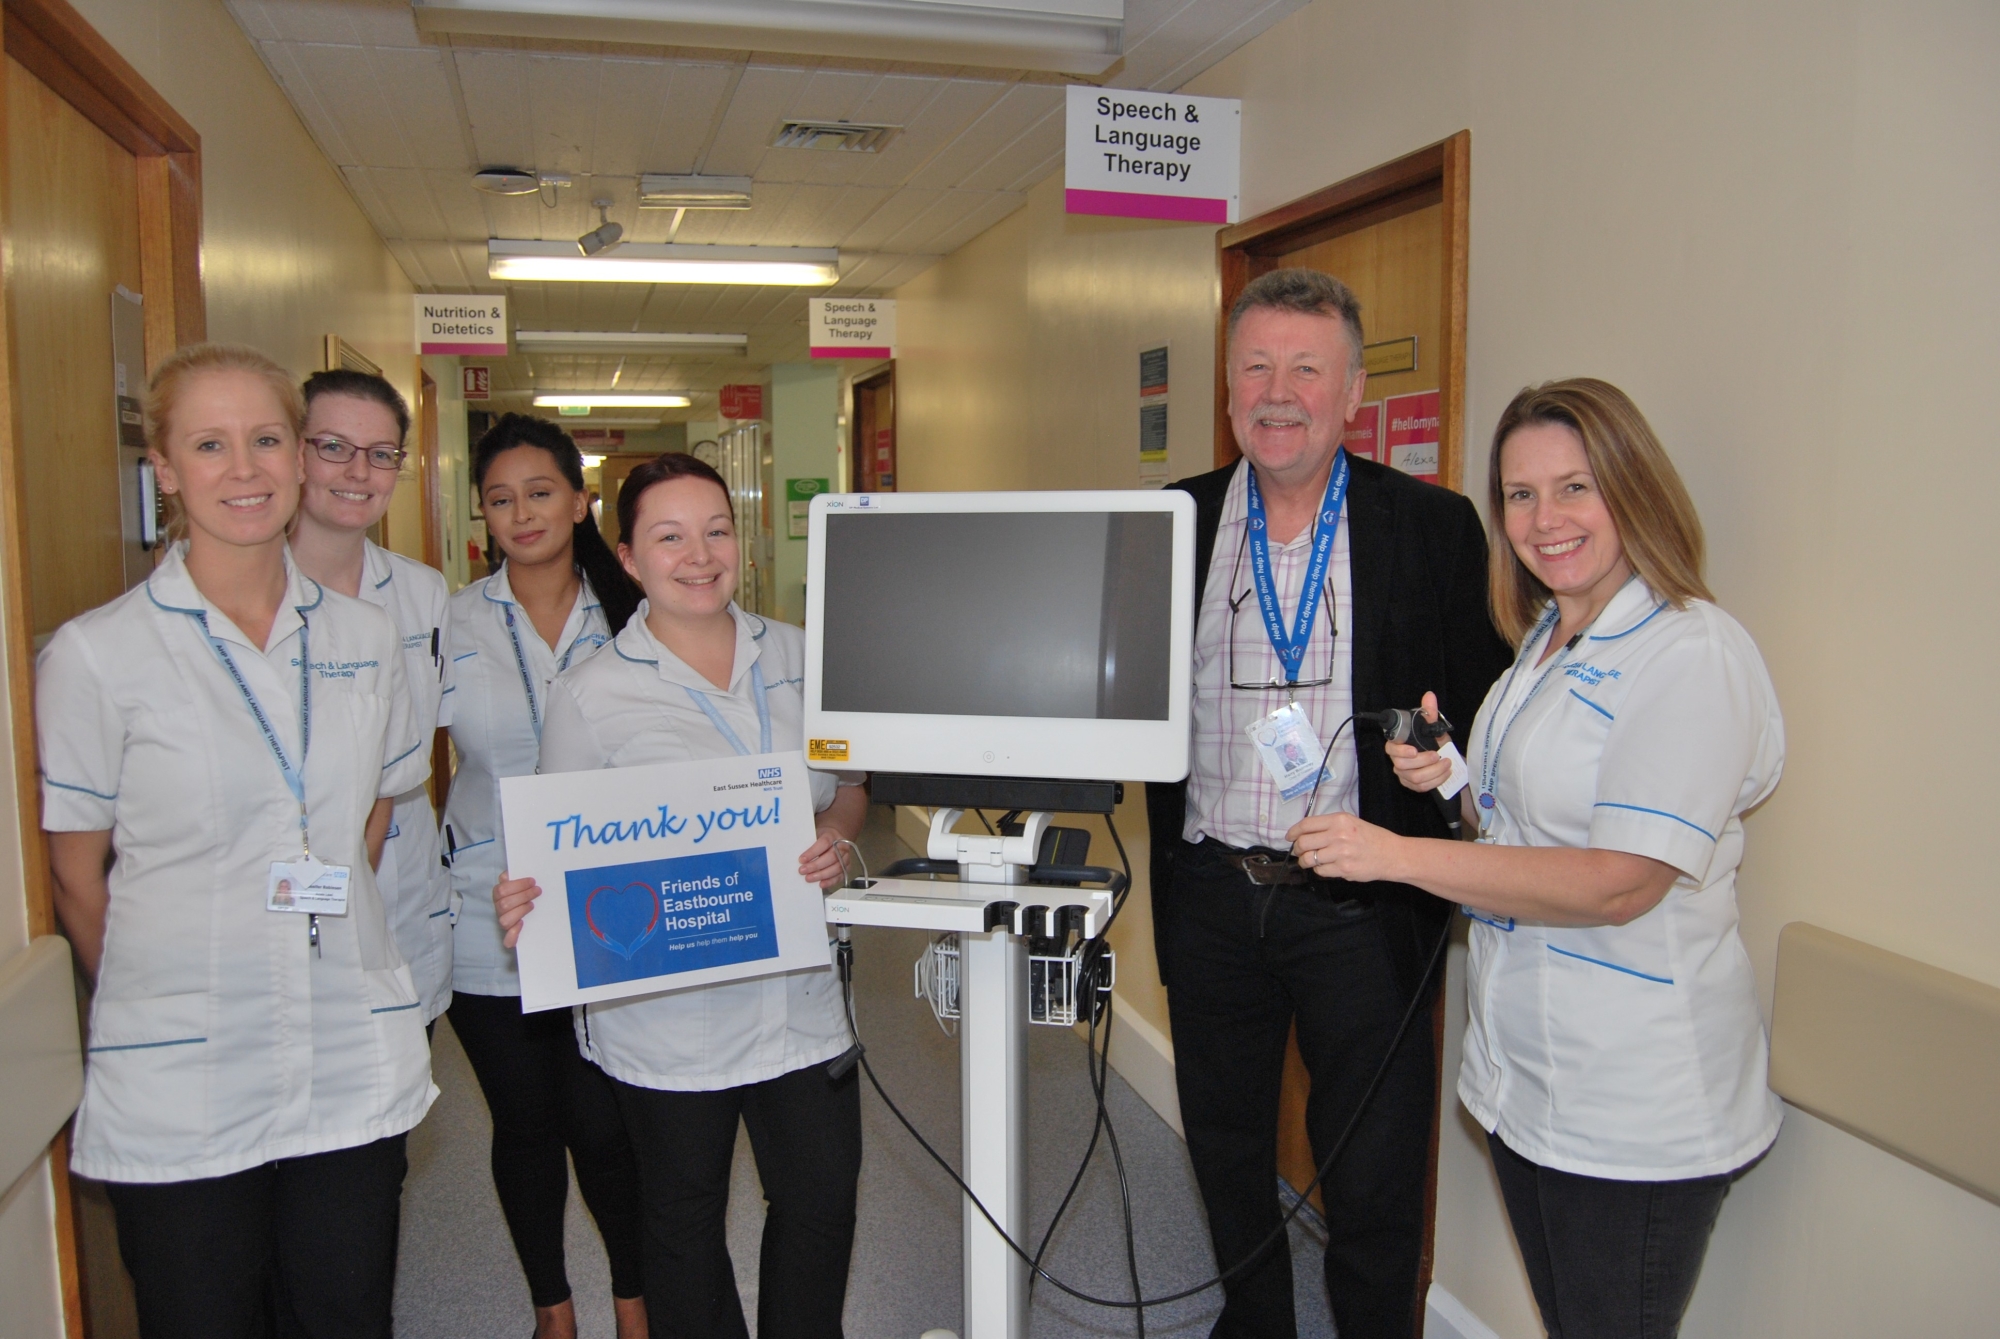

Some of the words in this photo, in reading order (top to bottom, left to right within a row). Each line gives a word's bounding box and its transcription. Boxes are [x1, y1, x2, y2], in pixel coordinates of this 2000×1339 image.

[1097, 96, 1176, 121] Speech
[1184, 104, 1199, 123] &
[1095, 124, 1201, 154] Language
[1103, 152, 1191, 182] Therapy
[424, 306, 486, 319] Nutrition
[491, 307, 501, 319] &
[824, 302, 865, 314] Speech
[868, 303, 876, 312] &
[432, 323, 494, 335] Dietetics
[824, 315, 877, 327] Language
[828, 328, 873, 340] Therapy
[1335, 472, 1346, 486] help
[1332, 487, 1340, 501] you
[1255, 541, 1264, 556] you
[1318, 534, 1330, 552] Help
[1256, 556, 1265, 574] help
[1316, 552, 1323, 563] us
[1311, 564, 1322, 583] help
[1260, 575, 1269, 594] them
[1307, 581, 1318, 600] them
[1264, 594, 1273, 611] help
[1303, 600, 1314, 618] help
[1268, 612, 1275, 622] us
[1271, 623, 1281, 640] Help
[1300, 618, 1308, 635] you
[328, 661, 335, 669] &
[336, 659, 379, 670] Language
[319, 670, 356, 678] Therapy
[216, 644, 228, 658] AHP
[224, 656, 243, 685] SPEECH
[240, 684, 252, 698] AND
[248, 697, 271, 735] LANGUAGE
[267, 734, 291, 771] THERAPIST
[528, 694, 539, 724] THERAPIST
[810, 739, 826, 750] EME
[759, 768, 780, 778] NHS
[727, 782, 748, 791] Sussex
[750, 779, 782, 788] Healthcare
[547, 803, 688, 850] Thank
[693, 797, 781, 843] you!
[661, 875, 721, 895] Friends
[725, 871, 739, 887] of
[663, 890, 753, 913] Eastbourne
[665, 908, 731, 931] Hospital
[669, 942, 685, 951] Help
[686, 941, 695, 949] us
[696, 939, 711, 948] help
[711, 936, 728, 944] them
[729, 934, 744, 943] help
[744, 932, 758, 942] you
